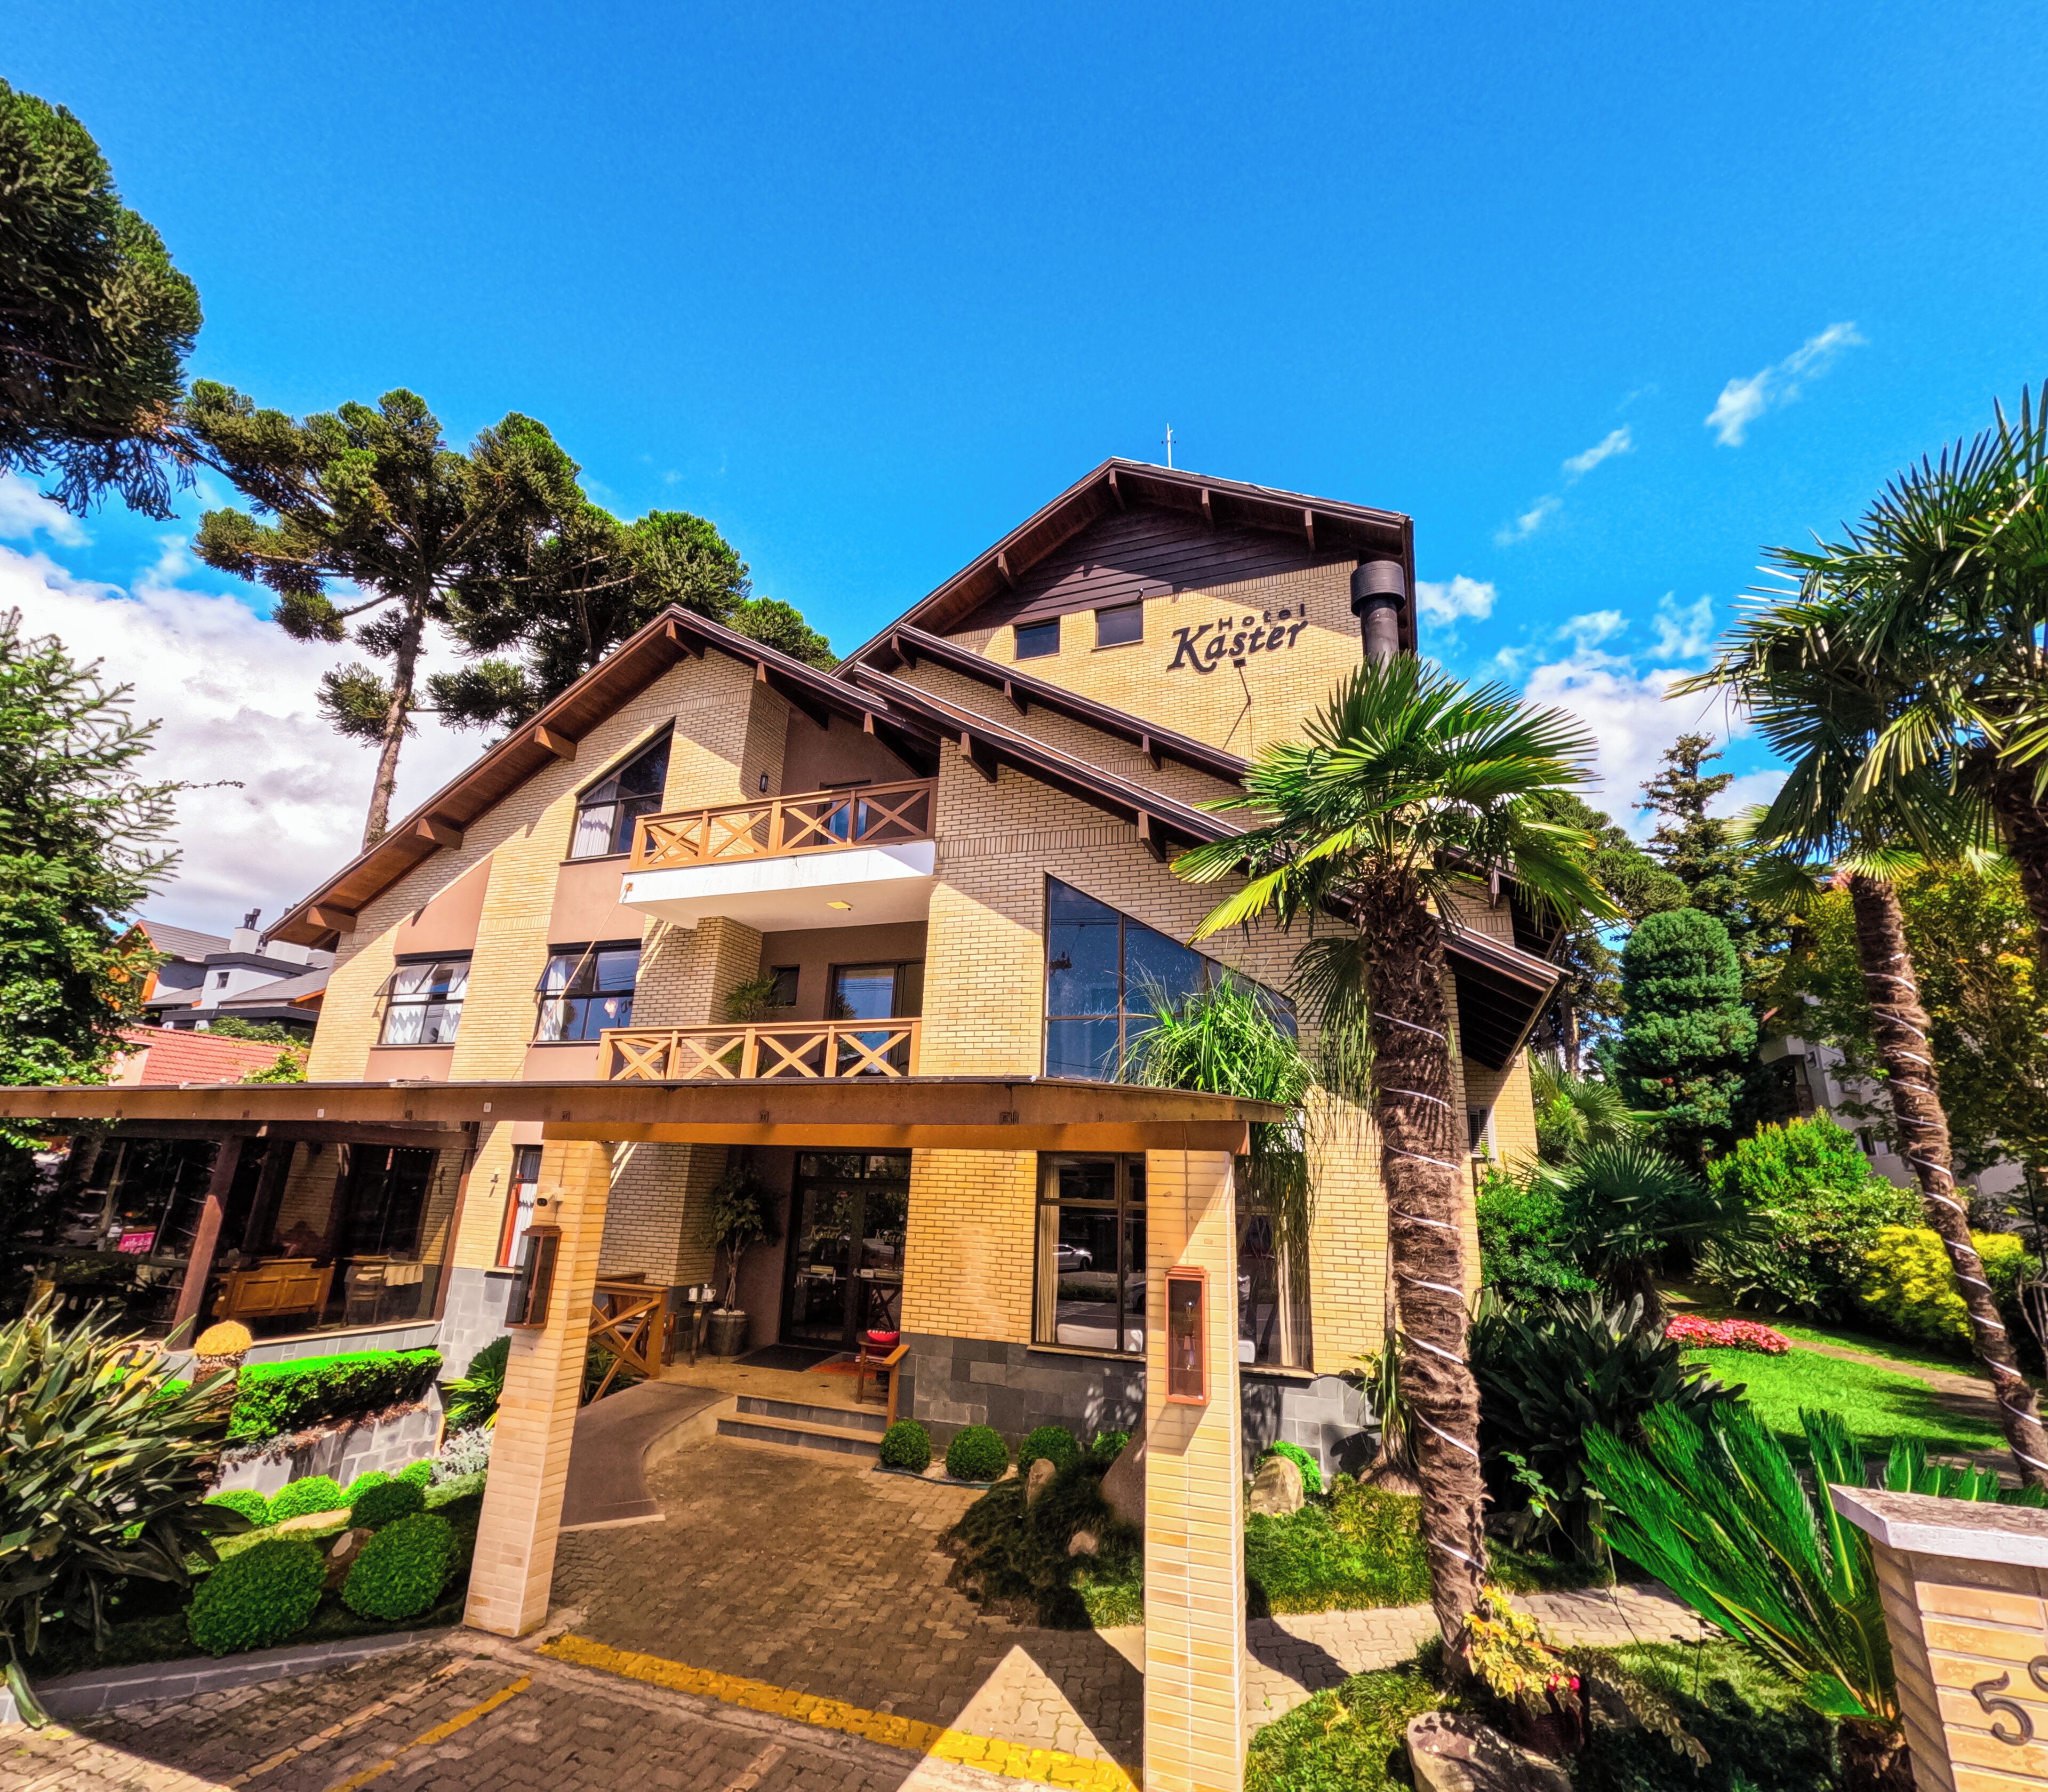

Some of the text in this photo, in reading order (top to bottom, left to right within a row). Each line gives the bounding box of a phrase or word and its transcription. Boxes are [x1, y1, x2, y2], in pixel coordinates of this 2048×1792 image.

[1218, 603, 1305, 632] Hotel
[1166, 620, 1308, 675] Kaster
[811, 1225, 842, 1241] Kaster
